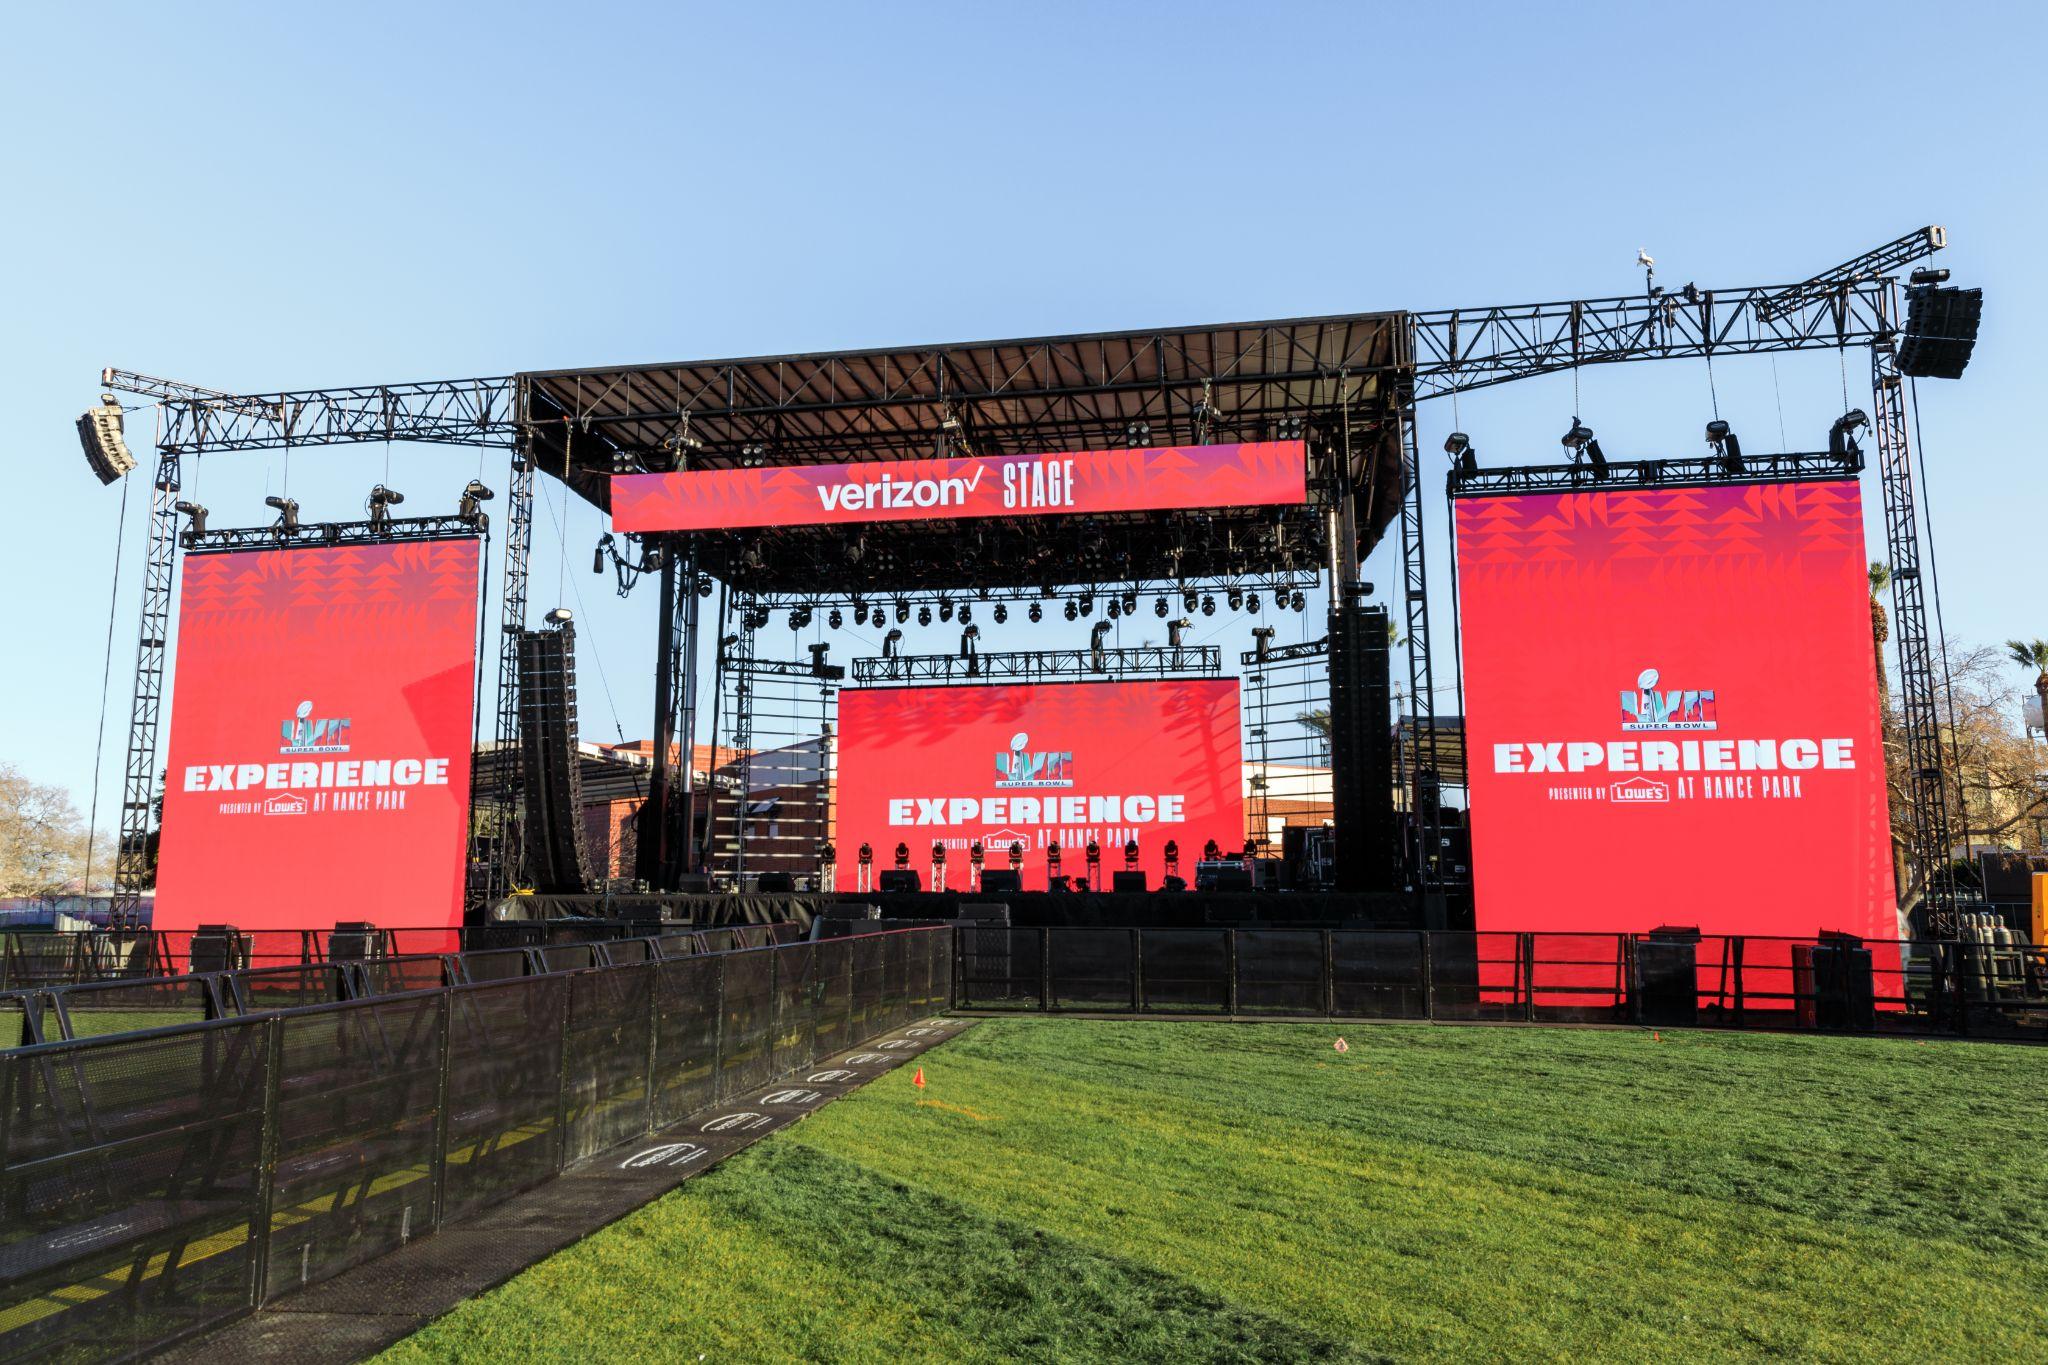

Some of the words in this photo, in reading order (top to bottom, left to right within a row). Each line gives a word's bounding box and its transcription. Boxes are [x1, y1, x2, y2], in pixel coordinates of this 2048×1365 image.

[817, 473, 964, 511] verizon
[1003, 460, 1074, 509] STAGE
[1493, 738, 1856, 774] EXPERIENCE
[184, 758, 449, 792] EXPERIENCE
[1549, 787, 1593, 801] PRESENTED
[1596, 787, 1606, 800] BY
[1616, 786, 1664, 800] LOWE'S
[1678, 776, 1694, 799] AT
[1704, 776, 1753, 799] HANCE
[1762, 776, 1802, 799] PARK
[219, 803, 252, 815] PRESENTED
[254, 803, 262, 814] BY
[269, 801, 304, 813] LOWE'S
[313, 792, 327, 812] AT
[333, 791, 369, 811] HANCE
[376, 790, 406, 811] PARK
[889, 795, 1185, 826] EXPERIENCE
[1037, 829, 1052, 849] AT
[1107, 828, 1139, 848] PARK
